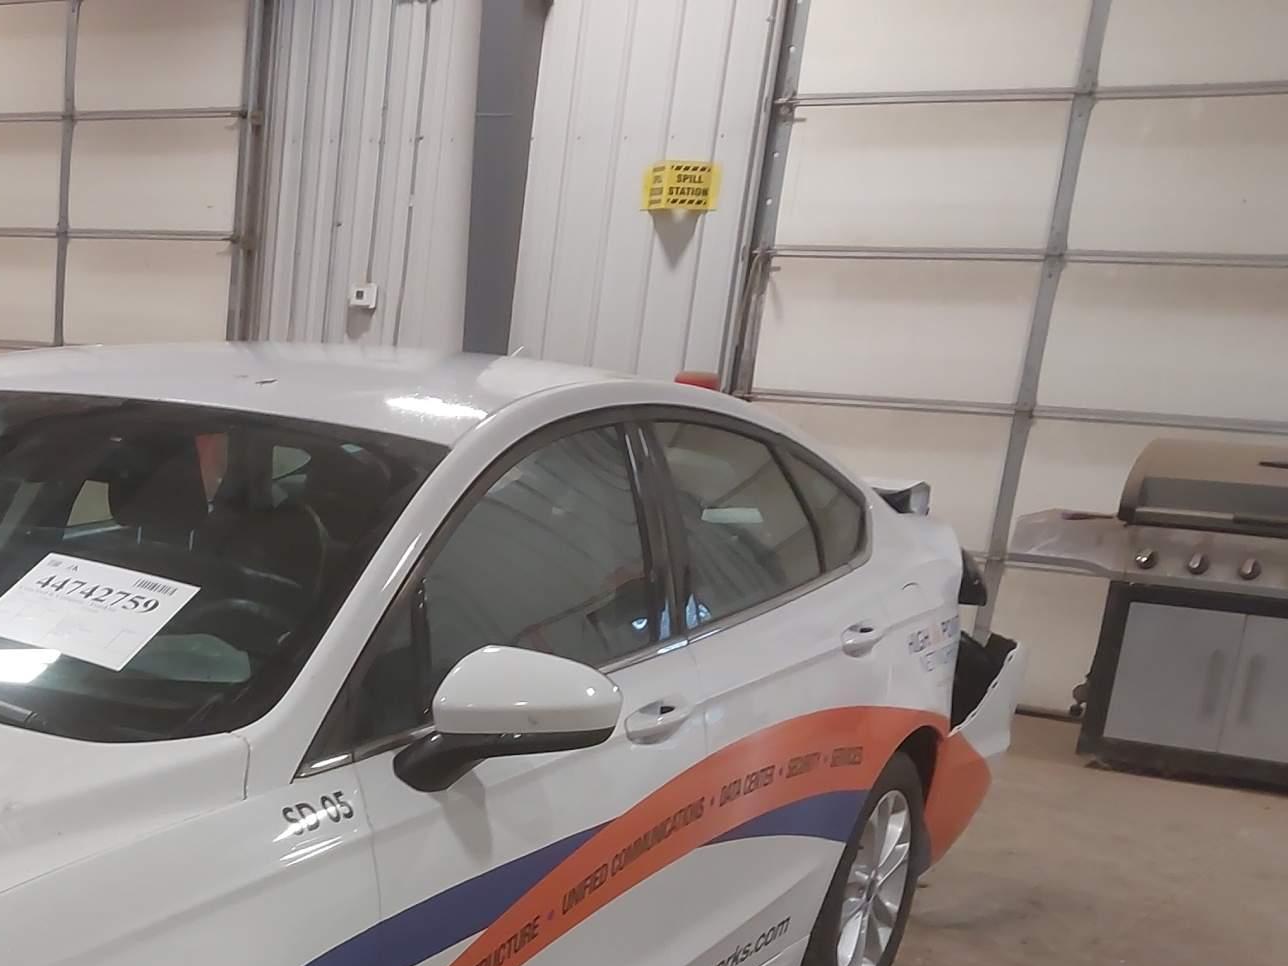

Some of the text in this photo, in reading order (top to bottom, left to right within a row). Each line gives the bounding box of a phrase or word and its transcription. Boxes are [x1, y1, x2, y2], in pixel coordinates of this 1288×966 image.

[668, 186, 709, 197] STATION
[675, 173, 704, 184] SPILL
[35, 574, 161, 614] 44742759
[282, 790, 355, 836] SD 05
[561, 862, 609, 916] UNIFIED
[610, 796, 706, 878] COMMUNICATIONS
[718, 778, 743, 807] DATA
[742, 764, 777, 796] CENTER
